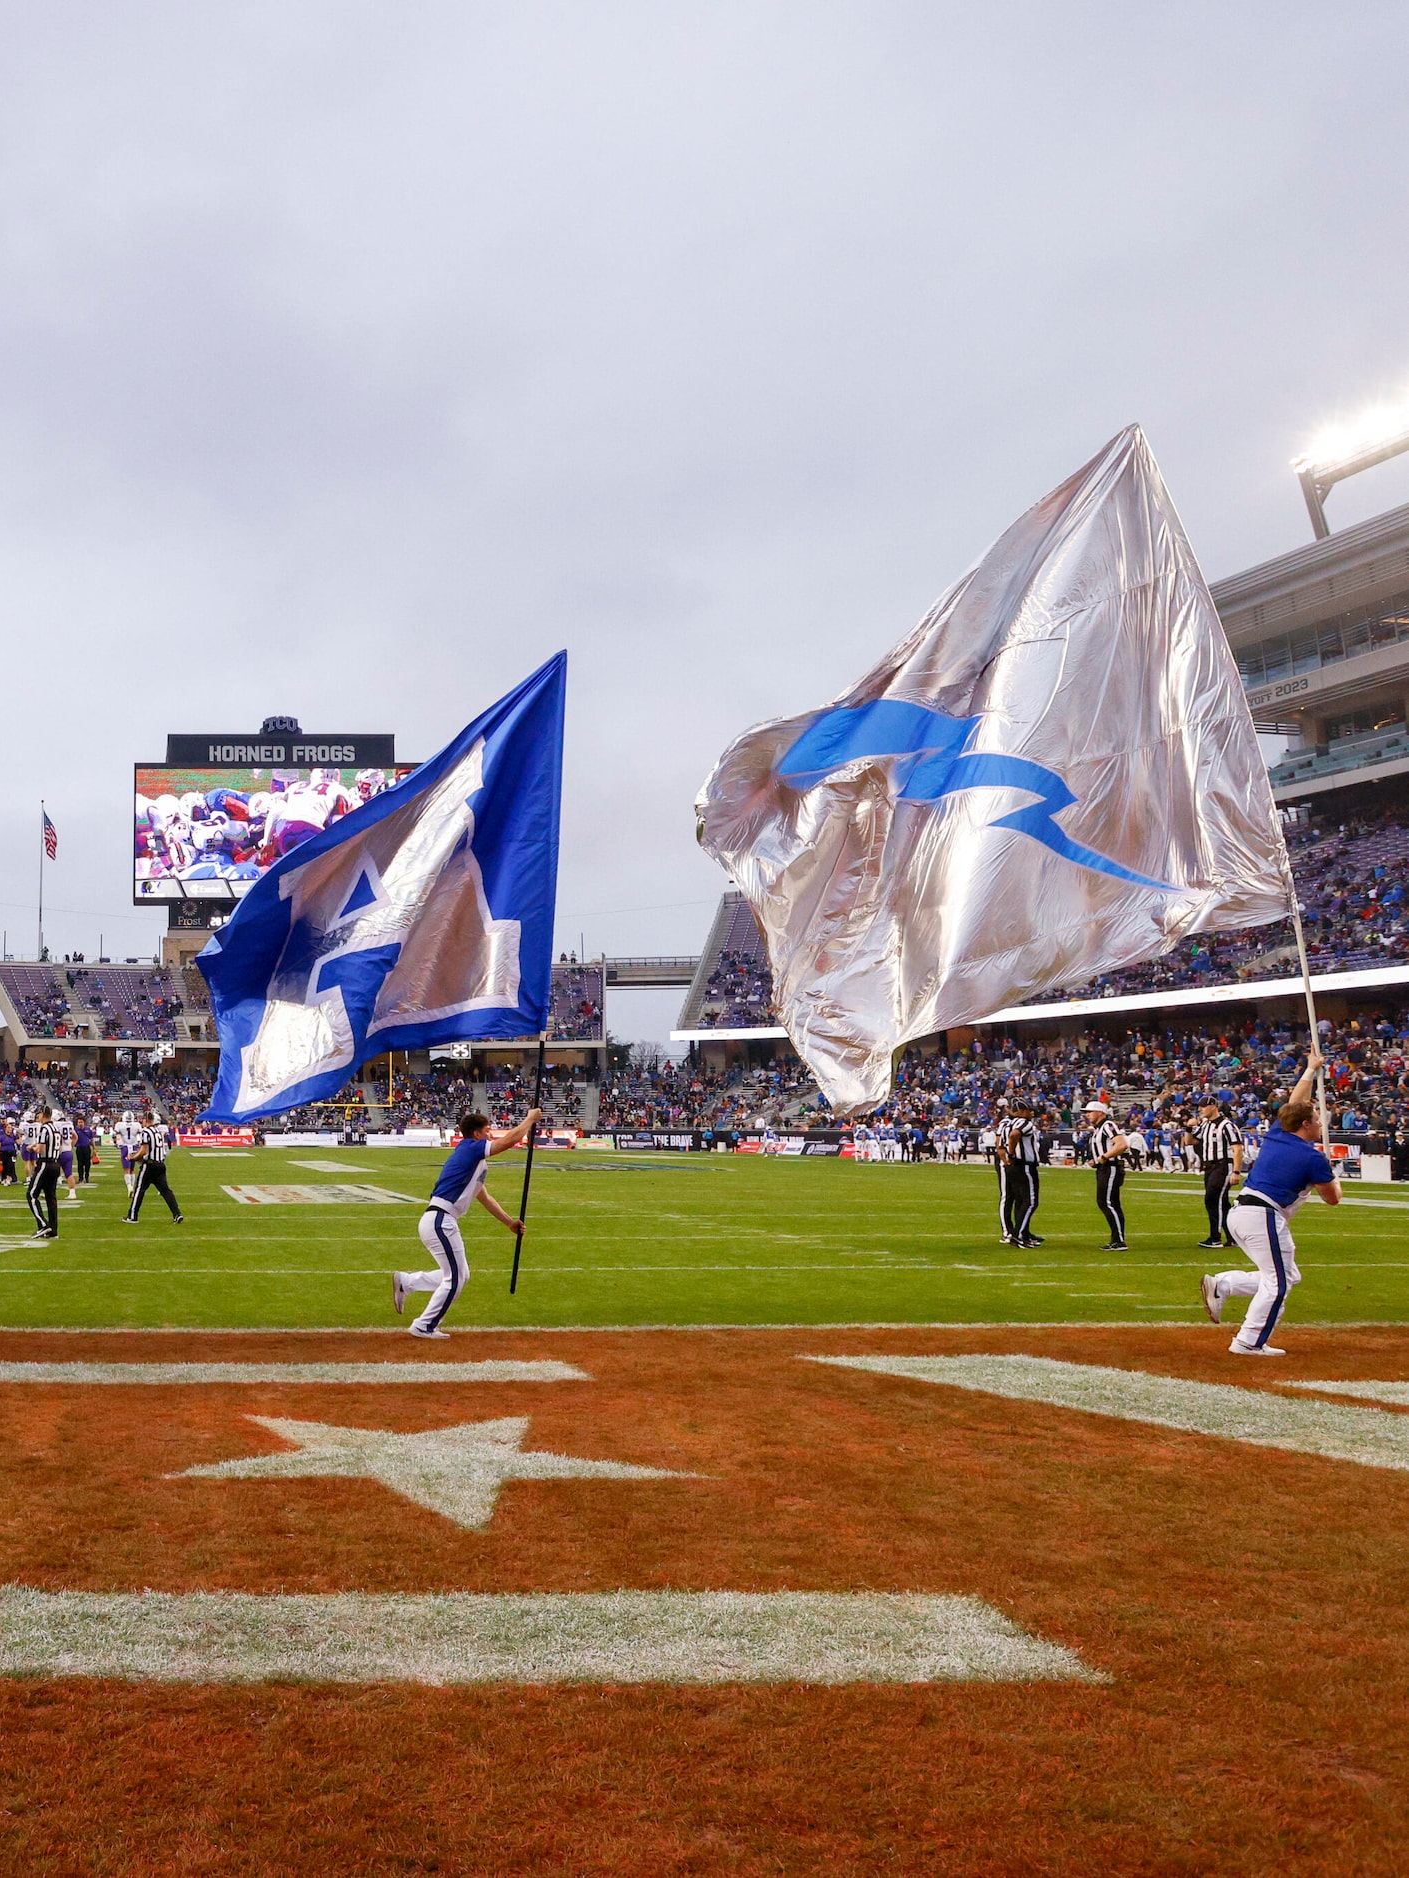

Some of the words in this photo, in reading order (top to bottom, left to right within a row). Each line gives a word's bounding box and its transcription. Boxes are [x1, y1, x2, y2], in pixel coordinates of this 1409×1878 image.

[1275, 678, 1309, 698] 2023
[264, 715, 298, 733] TCU
[208, 744, 286, 763] HORNED
[292, 744, 356, 763] FROGS
[177, 915, 203, 926] Frost
[233, 734, 522, 1113] A
[156, 1042, 173, 1057] 25
[452, 1044, 469, 1057] 25
[126, 1127, 132, 1140] 1
[653, 1134, 669, 1147] THE
[670, 1134, 694, 1147] BRAVE
